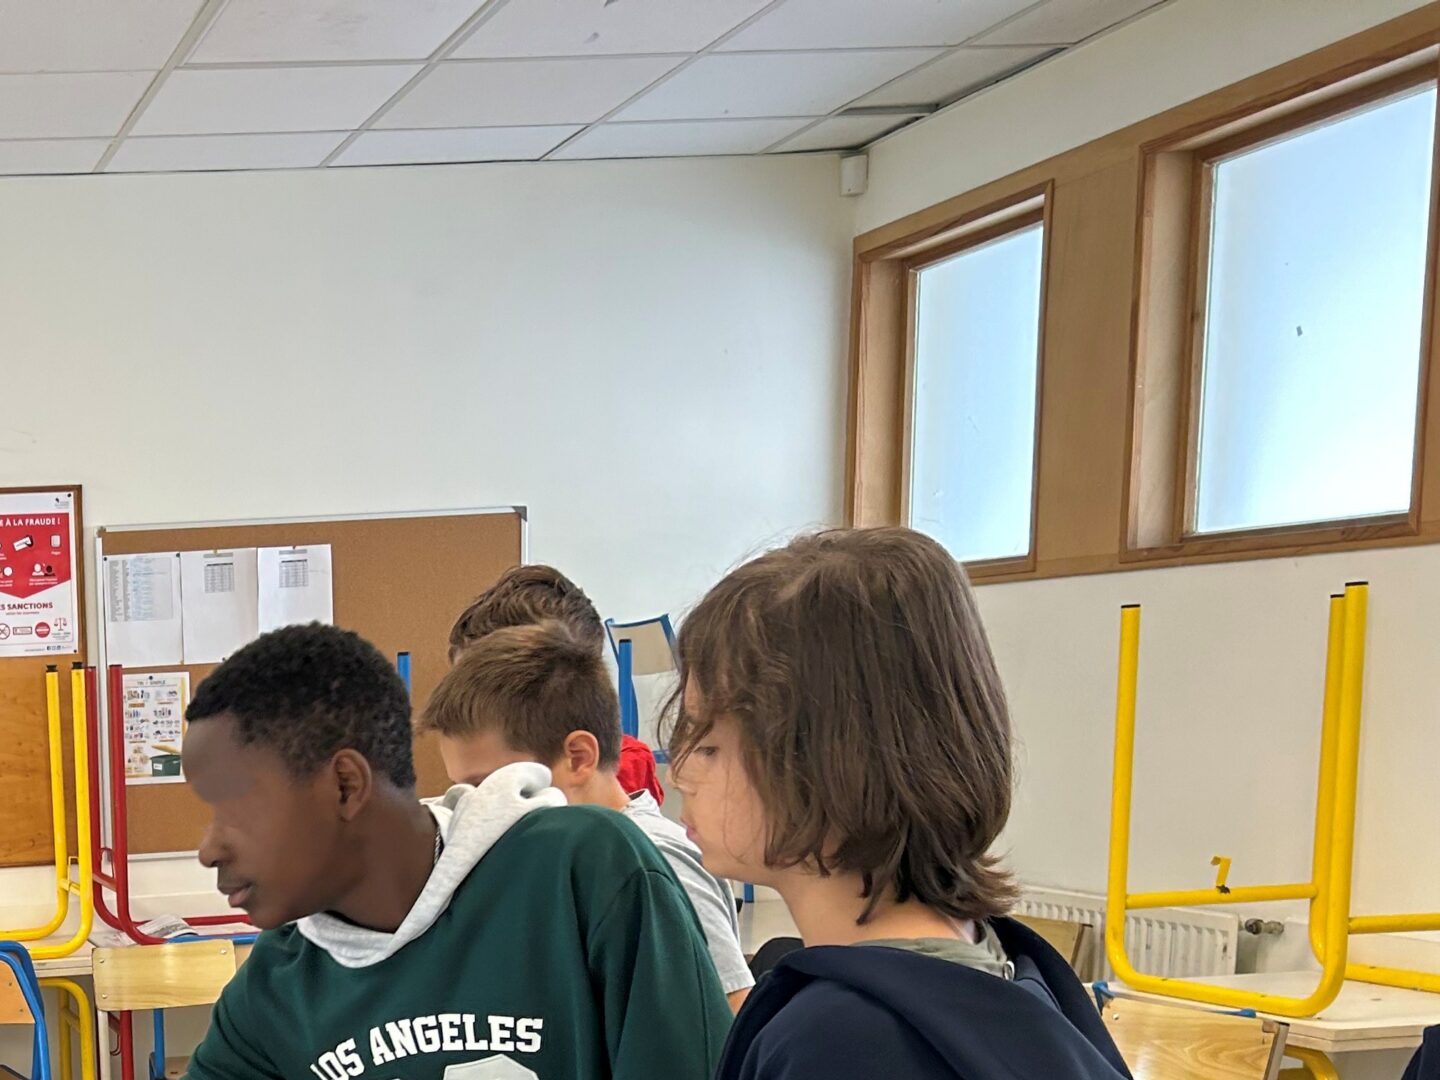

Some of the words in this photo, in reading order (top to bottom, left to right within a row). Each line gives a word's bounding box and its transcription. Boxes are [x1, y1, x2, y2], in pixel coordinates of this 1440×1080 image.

[25, 518, 56, 526] FRAUDE
[7, 602, 54, 610] SANCTIONS
[369, 1013, 543, 1066] ANGELES
